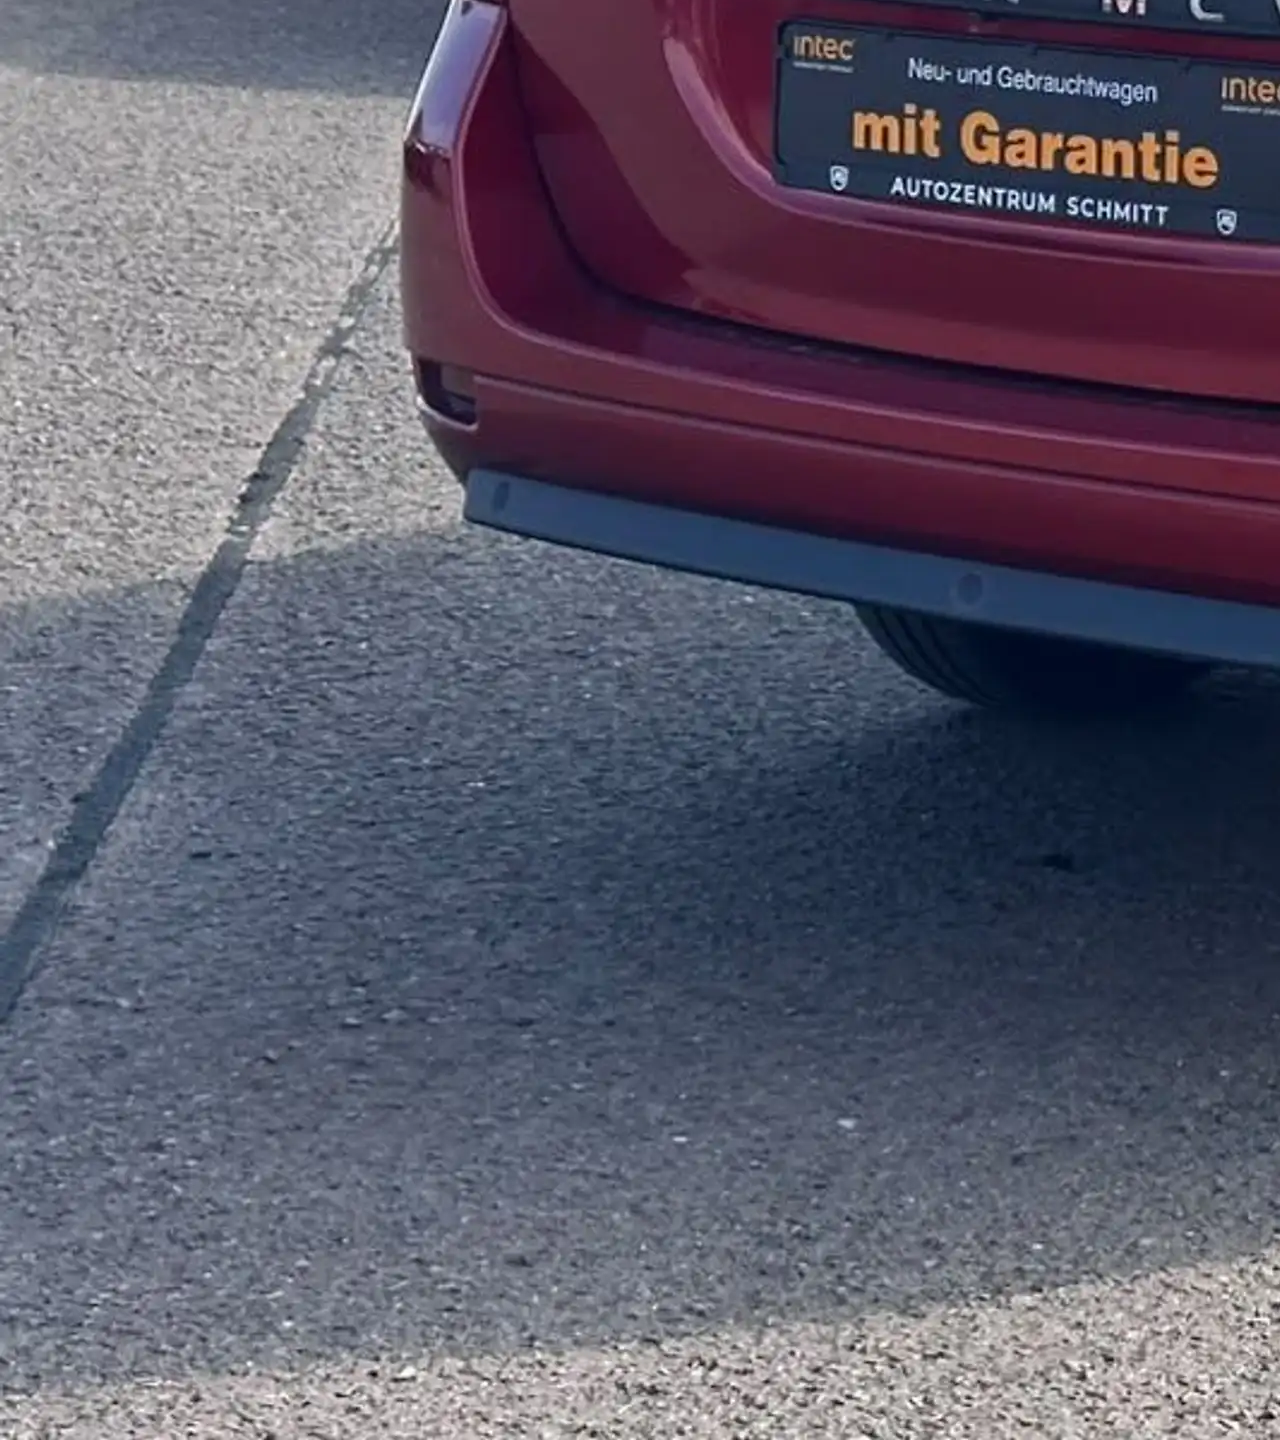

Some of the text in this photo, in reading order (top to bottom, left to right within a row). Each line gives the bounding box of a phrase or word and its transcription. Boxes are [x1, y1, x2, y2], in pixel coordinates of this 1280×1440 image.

[793, 35, 855, 61] intec
[909, 58, 1158, 106] Neu- und Gebrauchtwagen
[852, 103, 1220, 189] mit Garantie
[890, 177, 1169, 226] AUTOZENTRUM SCHMITT
